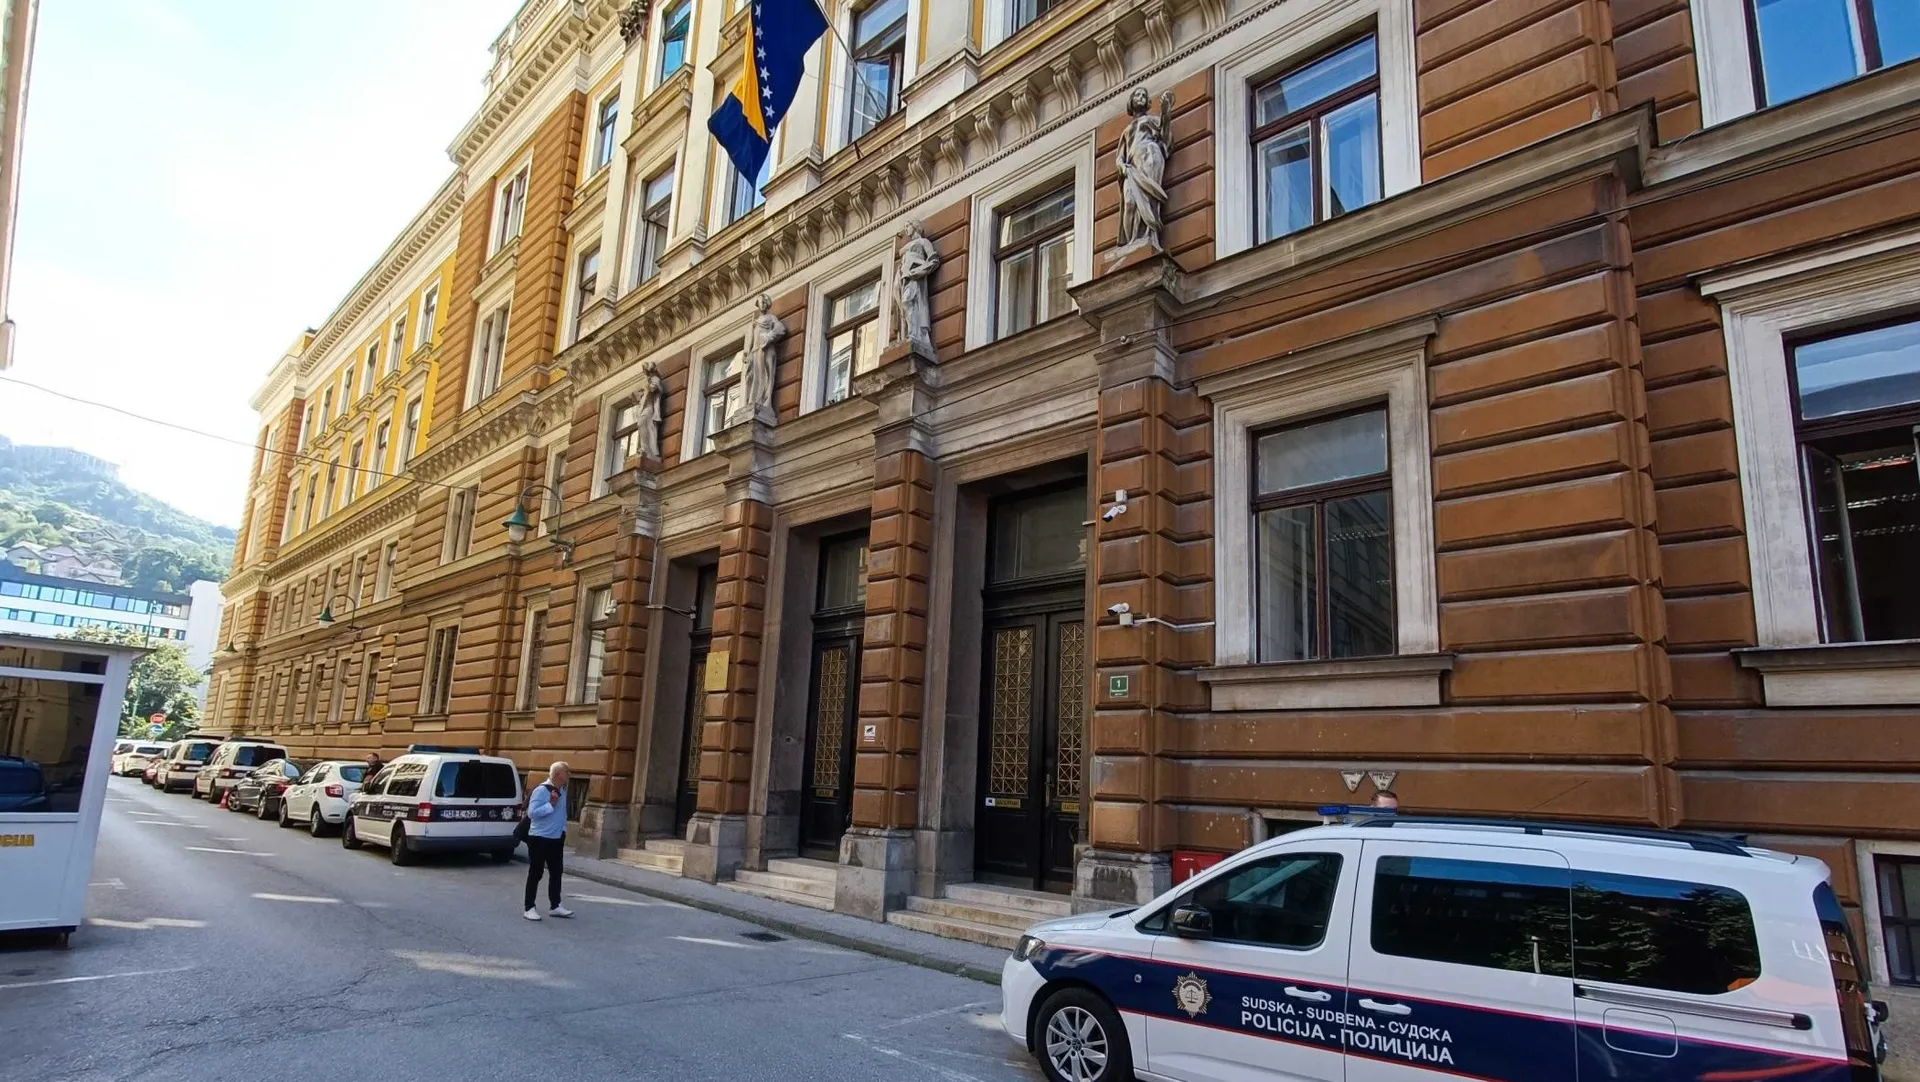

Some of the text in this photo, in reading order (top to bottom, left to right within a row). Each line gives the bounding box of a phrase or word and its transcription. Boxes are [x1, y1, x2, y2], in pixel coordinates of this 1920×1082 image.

[1116, 679, 1121, 688] 1
[1241, 996, 1296, 1016] SUDSKA
[1306, 1006, 1377, 1030] SUDBENA
[1388, 1021, 1453, 1043] СУДСКА
[1241, 1011, 1325, 1040] POLICIJA
[1340, 1028, 1454, 1065] ПОЛИЦИЈА
